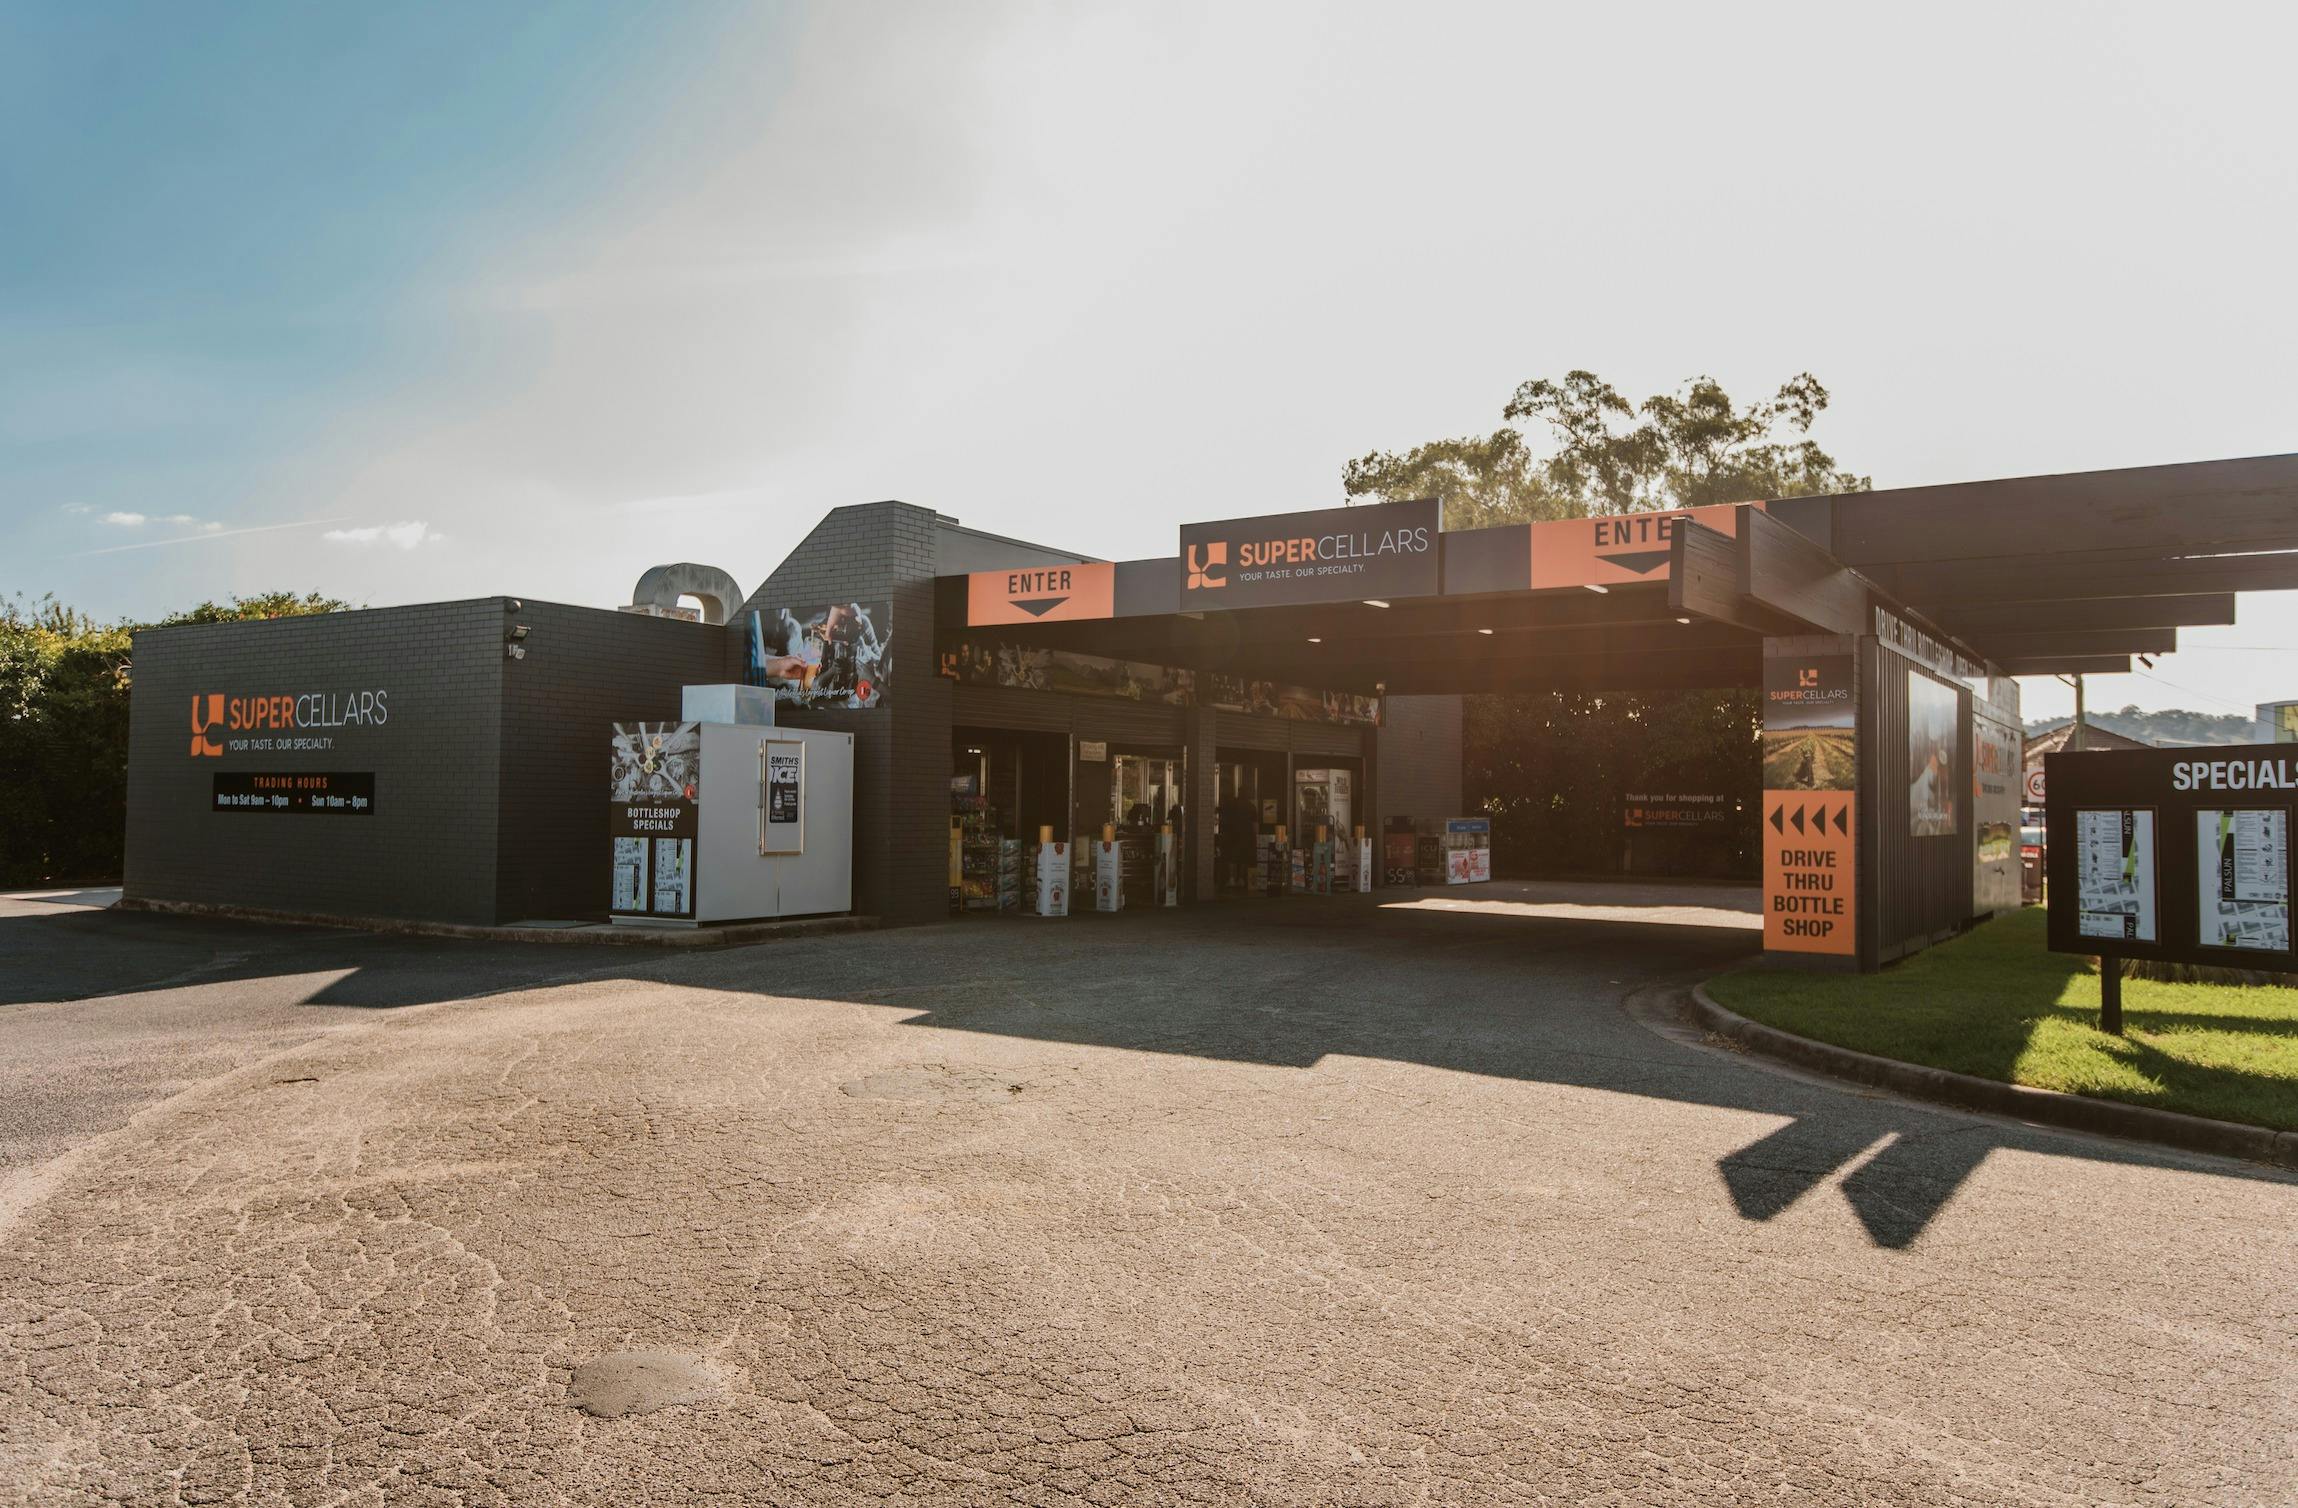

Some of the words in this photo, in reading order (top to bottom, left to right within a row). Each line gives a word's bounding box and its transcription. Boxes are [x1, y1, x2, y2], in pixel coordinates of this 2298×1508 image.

[1595, 514, 1694, 547] ENTE
[1239, 527, 1428, 567] SUPERCELLARS
[1008, 570, 1071, 594] ENTER
[1239, 572, 1262, 582] YOUR
[1295, 567, 1314, 577] OUR
[1317, 563, 1366, 575] SPECIALTY.
[1875, 605, 1898, 643] DRIVE
[1770, 689, 1848, 700] SUPERCELLARS
[229, 690, 388, 730] SUPERCELLARS
[229, 739, 249, 751] YOUR
[251, 738, 275, 750] TASTE.
[276, 738, 292, 750] OUR
[293, 737, 335, 750] SPECIALTY.
[253, 777, 293, 789] TRADING
[297, 777, 328, 789] HOURS
[2173, 759, 2298, 791] SPECIAL
[217, 793, 231, 806] Mon
[231, 794, 239, 806] to
[239, 794, 250, 806] Sat
[250, 794, 265, 806] 9am
[271, 794, 289, 808] 10pm
[311, 795, 325, 807] Sun
[326, 795, 345, 808] 10am
[352, 796, 368, 810] 8pm
[1625, 793, 1649, 801] Thank
[1650, 794, 1664, 803] you
[1665, 793, 1678, 801] for
[1678, 793, 1714, 804] shopping
[1715, 794, 1724, 802] at
[627, 807, 681, 819] BOTTLESHOP
[1645, 810, 1725, 821] SUPERCELLARS
[633, 820, 674, 831] SPECIALS
[1781, 850, 1837, 868] DRIVE
[1783, 872, 1833, 891] THRU
[2223, 858, 2232, 893] PALSUN
[1774, 895, 1844, 915] BOTTLE
[1783, 918, 1834, 937] SHOP
